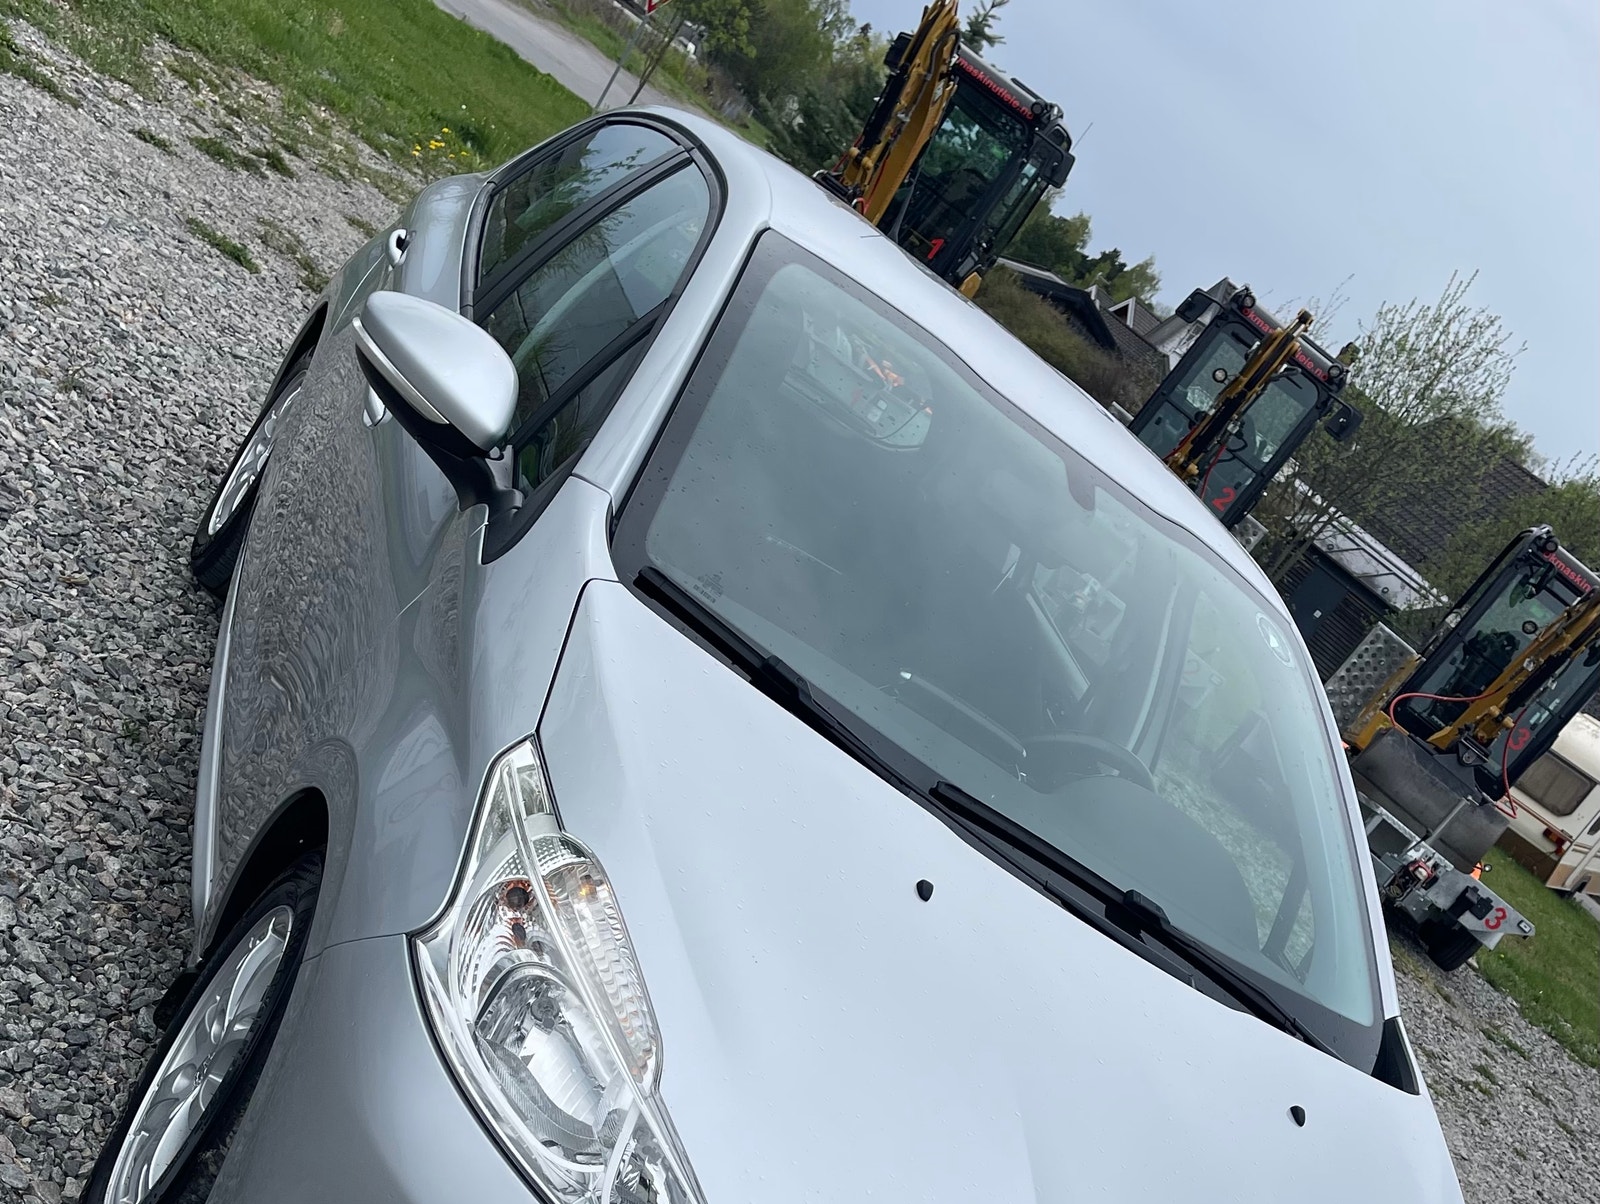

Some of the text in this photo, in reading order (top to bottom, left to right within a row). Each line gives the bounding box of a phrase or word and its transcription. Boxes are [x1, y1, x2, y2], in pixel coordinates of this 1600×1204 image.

[957, 57, 1033, 120] maskinutleie.no
[928, 238, 945, 260] 1
[1212, 487, 1236, 511] 2
[1507, 727, 1531, 750] 3
[1484, 906, 1507, 930] 3
